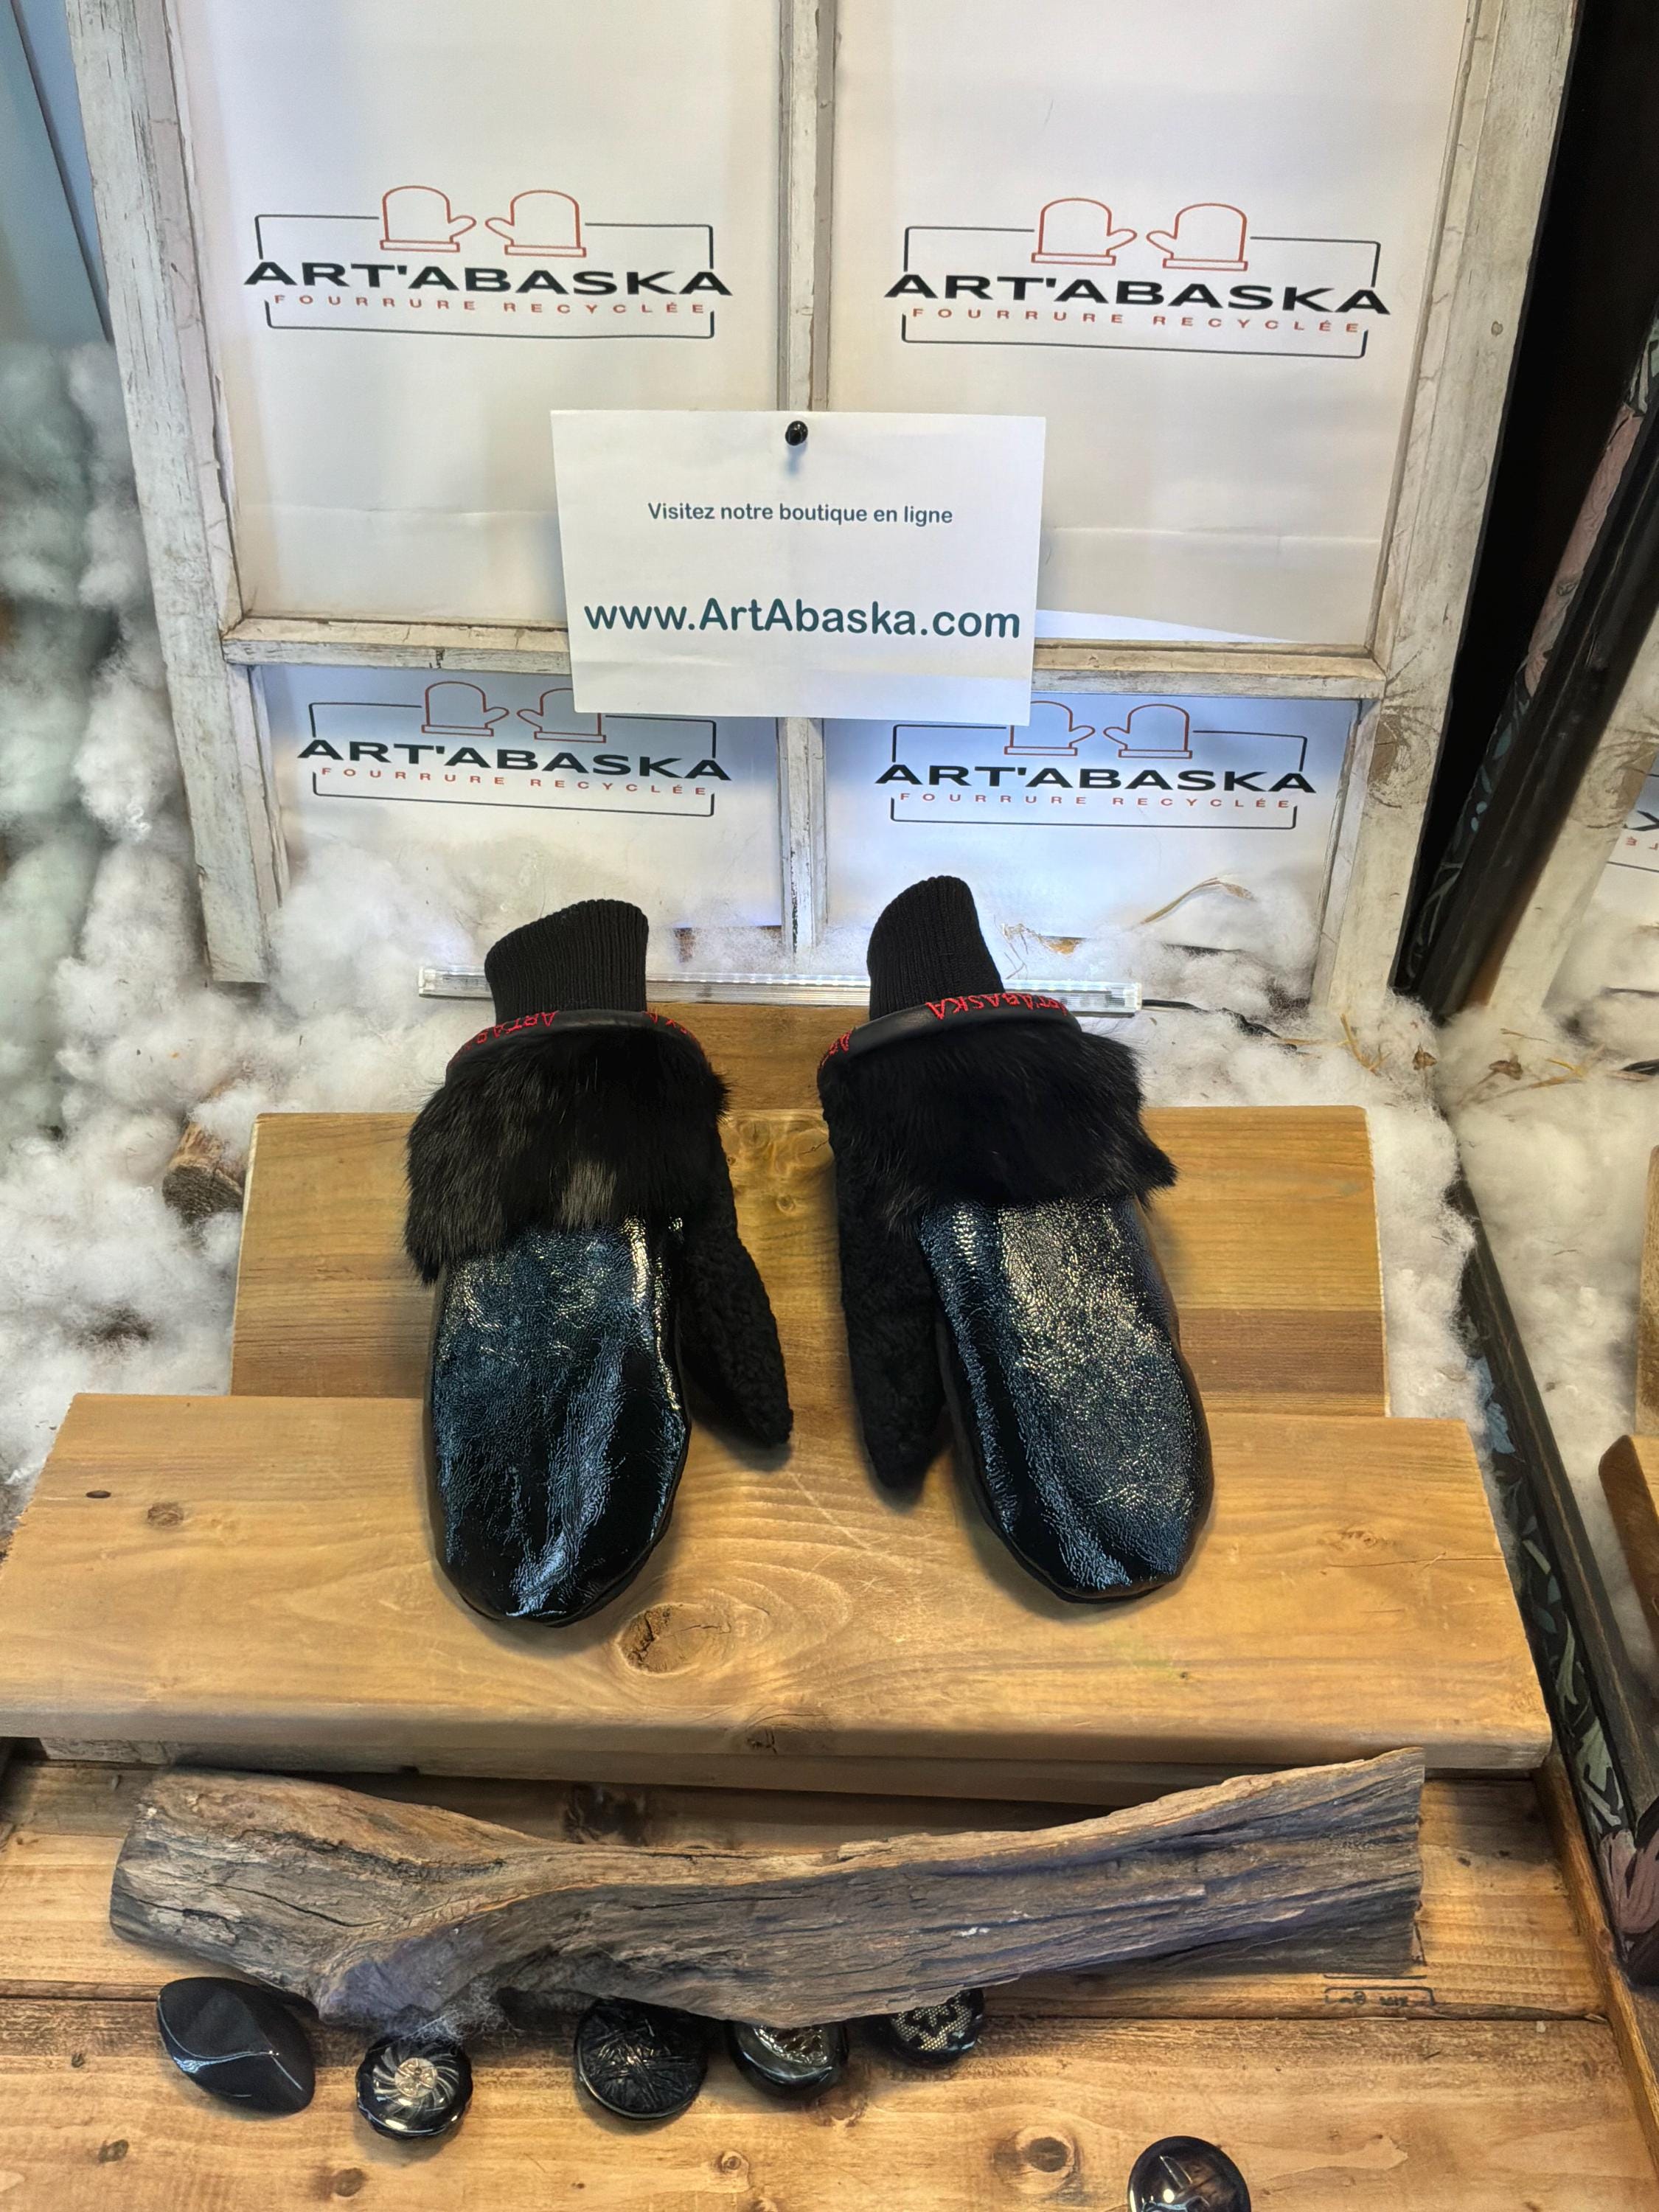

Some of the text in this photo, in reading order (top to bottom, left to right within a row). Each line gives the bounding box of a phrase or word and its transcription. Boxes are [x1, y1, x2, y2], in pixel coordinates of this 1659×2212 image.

[244, 260, 732, 296] ART'ABASKA
[274, 295, 704, 316] FOURRURE RECYCLÉE
[884, 274, 1390, 315] ART'ABASKA
[911, 307, 1360, 333] FOURRURE RECYCLÉE
[647, 502, 953, 527] Visitez notre boutique en ligne
[584, 597, 1020, 639] www.ArtAbaska.com
[298, 738, 732, 782] ART'ABASKA
[320, 768, 706, 796] FOURRURE RECYCLÉE
[875, 764, 1317, 794] ART'ABASKA
[900, 793, 1290, 809] FOURRURE RECYCLÉE
